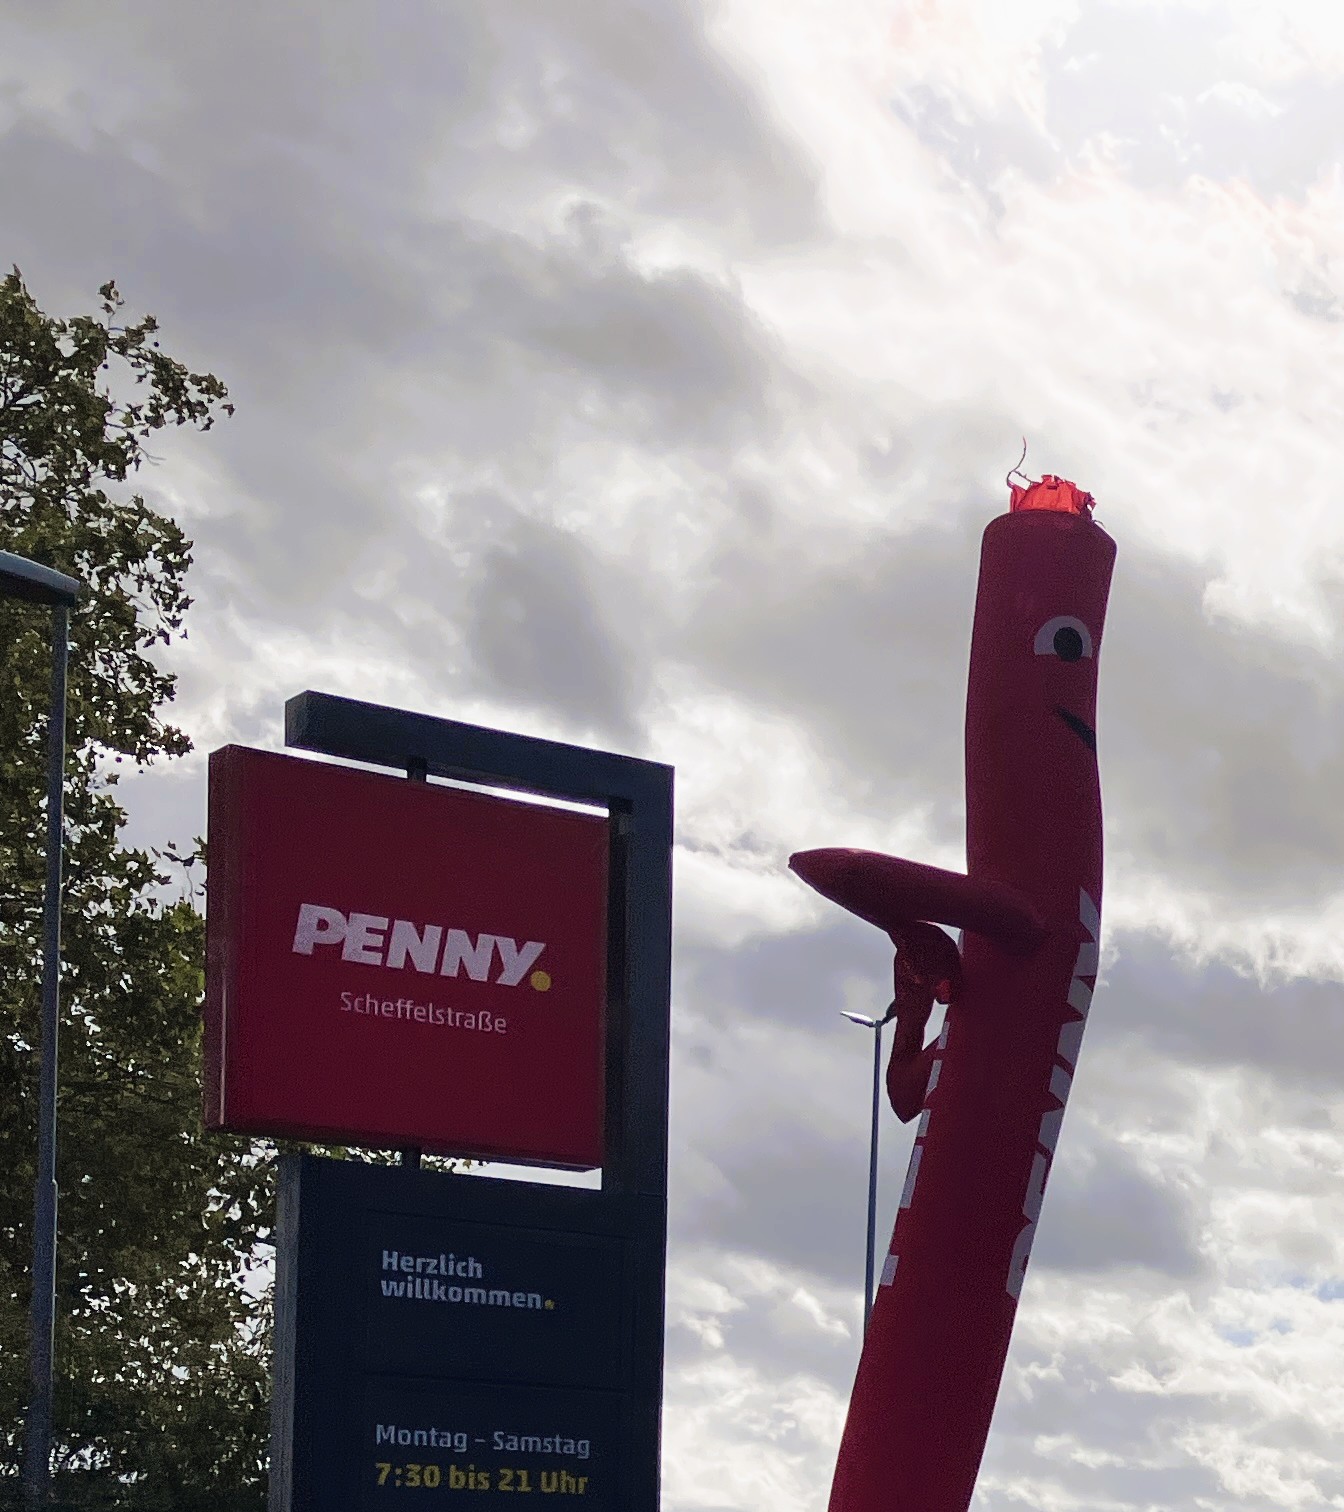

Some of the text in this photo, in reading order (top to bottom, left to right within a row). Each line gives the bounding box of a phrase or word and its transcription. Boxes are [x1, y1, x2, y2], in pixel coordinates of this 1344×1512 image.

[340, 992, 507, 1034] Scheffelstraße
[381, 1250, 483, 1279] Herzlich
[380, 1276, 555, 1310] willkommen.
[375, 1424, 468, 1453] Montag
[493, 1431, 591, 1459] Samstag
[375, 1462, 589, 1494] 7:30 bis 21 Uhr
